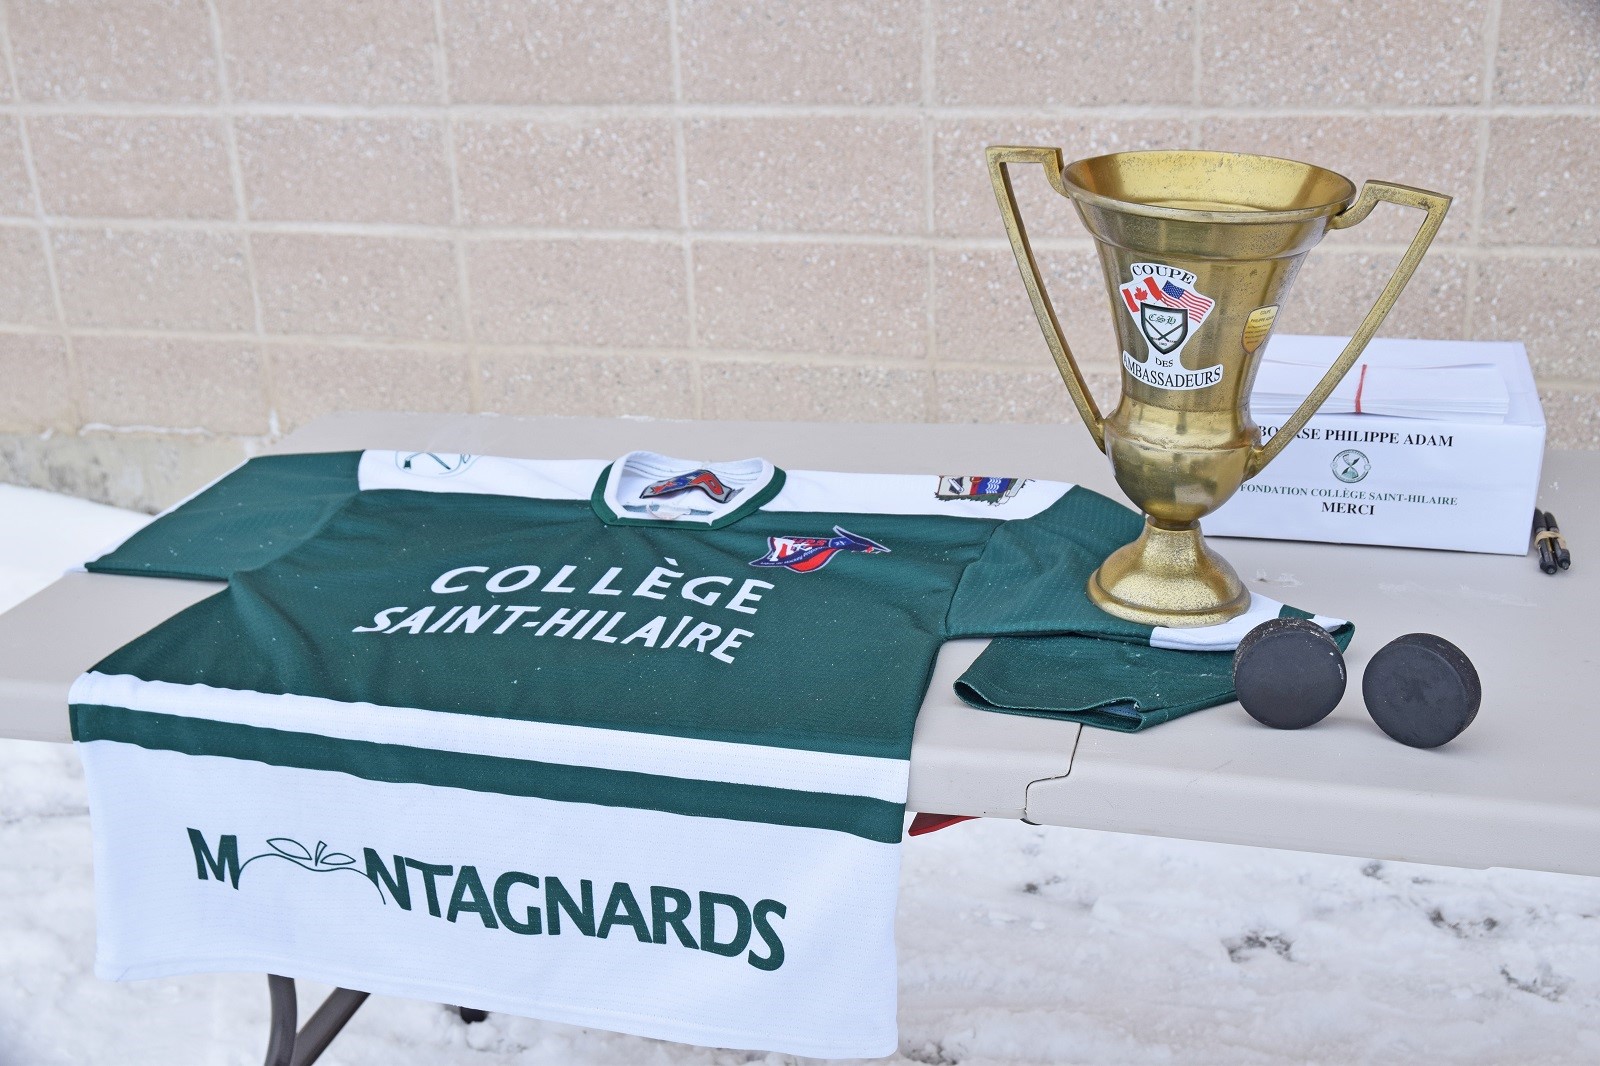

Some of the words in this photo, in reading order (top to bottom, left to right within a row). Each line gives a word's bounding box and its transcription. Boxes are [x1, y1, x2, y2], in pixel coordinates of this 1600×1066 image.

[1131, 264, 1195, 285] COUPE
[1123, 353, 1221, 388] AMBASSADEURS
[1154, 357, 1174, 368] DES
[1260, 425, 1321, 440] BOSE
[1325, 428, 1400, 444] PHILIPPE
[1403, 433, 1454, 447] ADAM
[1240, 483, 1308, 497] FONDATION
[1310, 486, 1366, 501] COLLÈGE
[1368, 491, 1458, 506] SAINT-HILAIRE
[1321, 501, 1375, 516] MERCI
[430, 556, 775, 615] COLLÈGE
[352, 605, 755, 664] SAINT-HILAIRE
